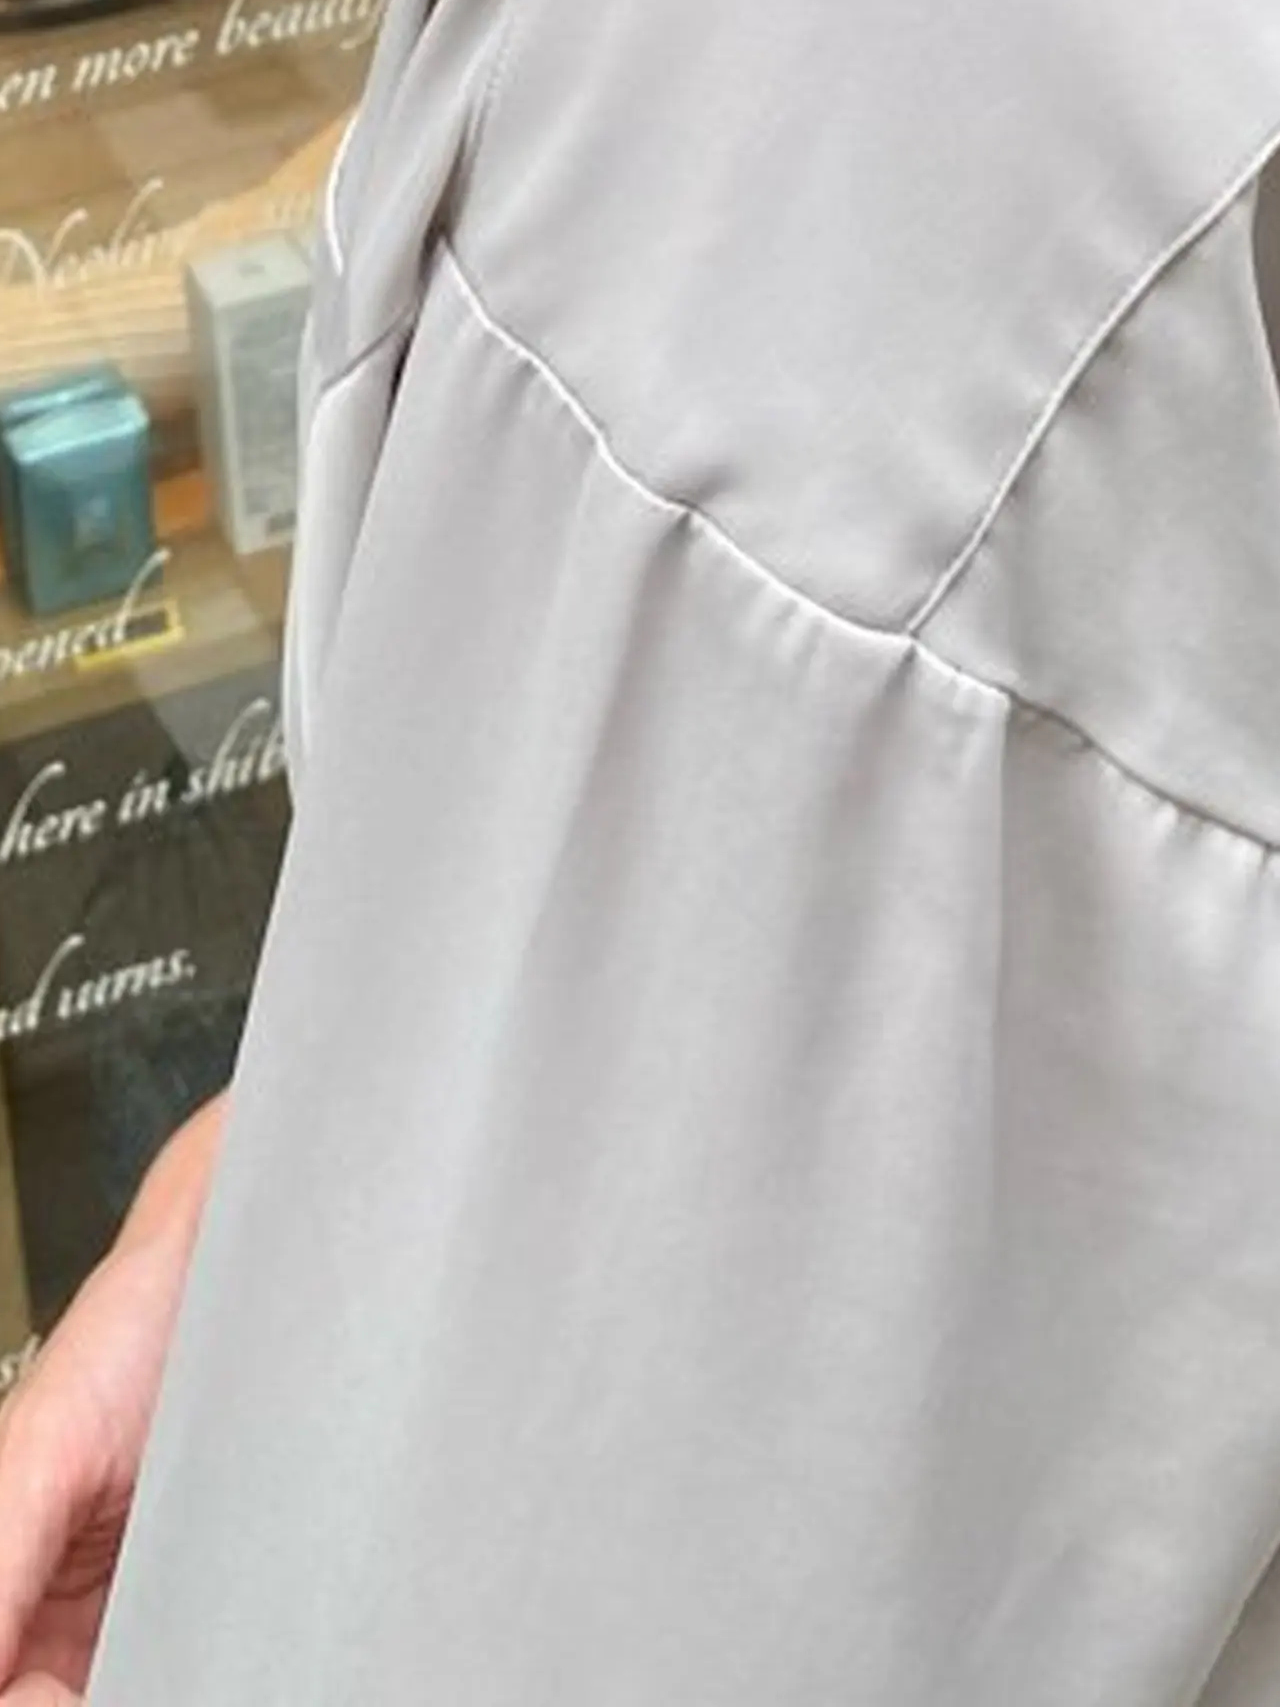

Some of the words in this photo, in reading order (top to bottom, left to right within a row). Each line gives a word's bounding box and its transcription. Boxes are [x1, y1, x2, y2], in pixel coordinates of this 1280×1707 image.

[70, 29, 202, 93] more
[118, 768, 170, 824] in
[180, 696, 287, 804] shib
